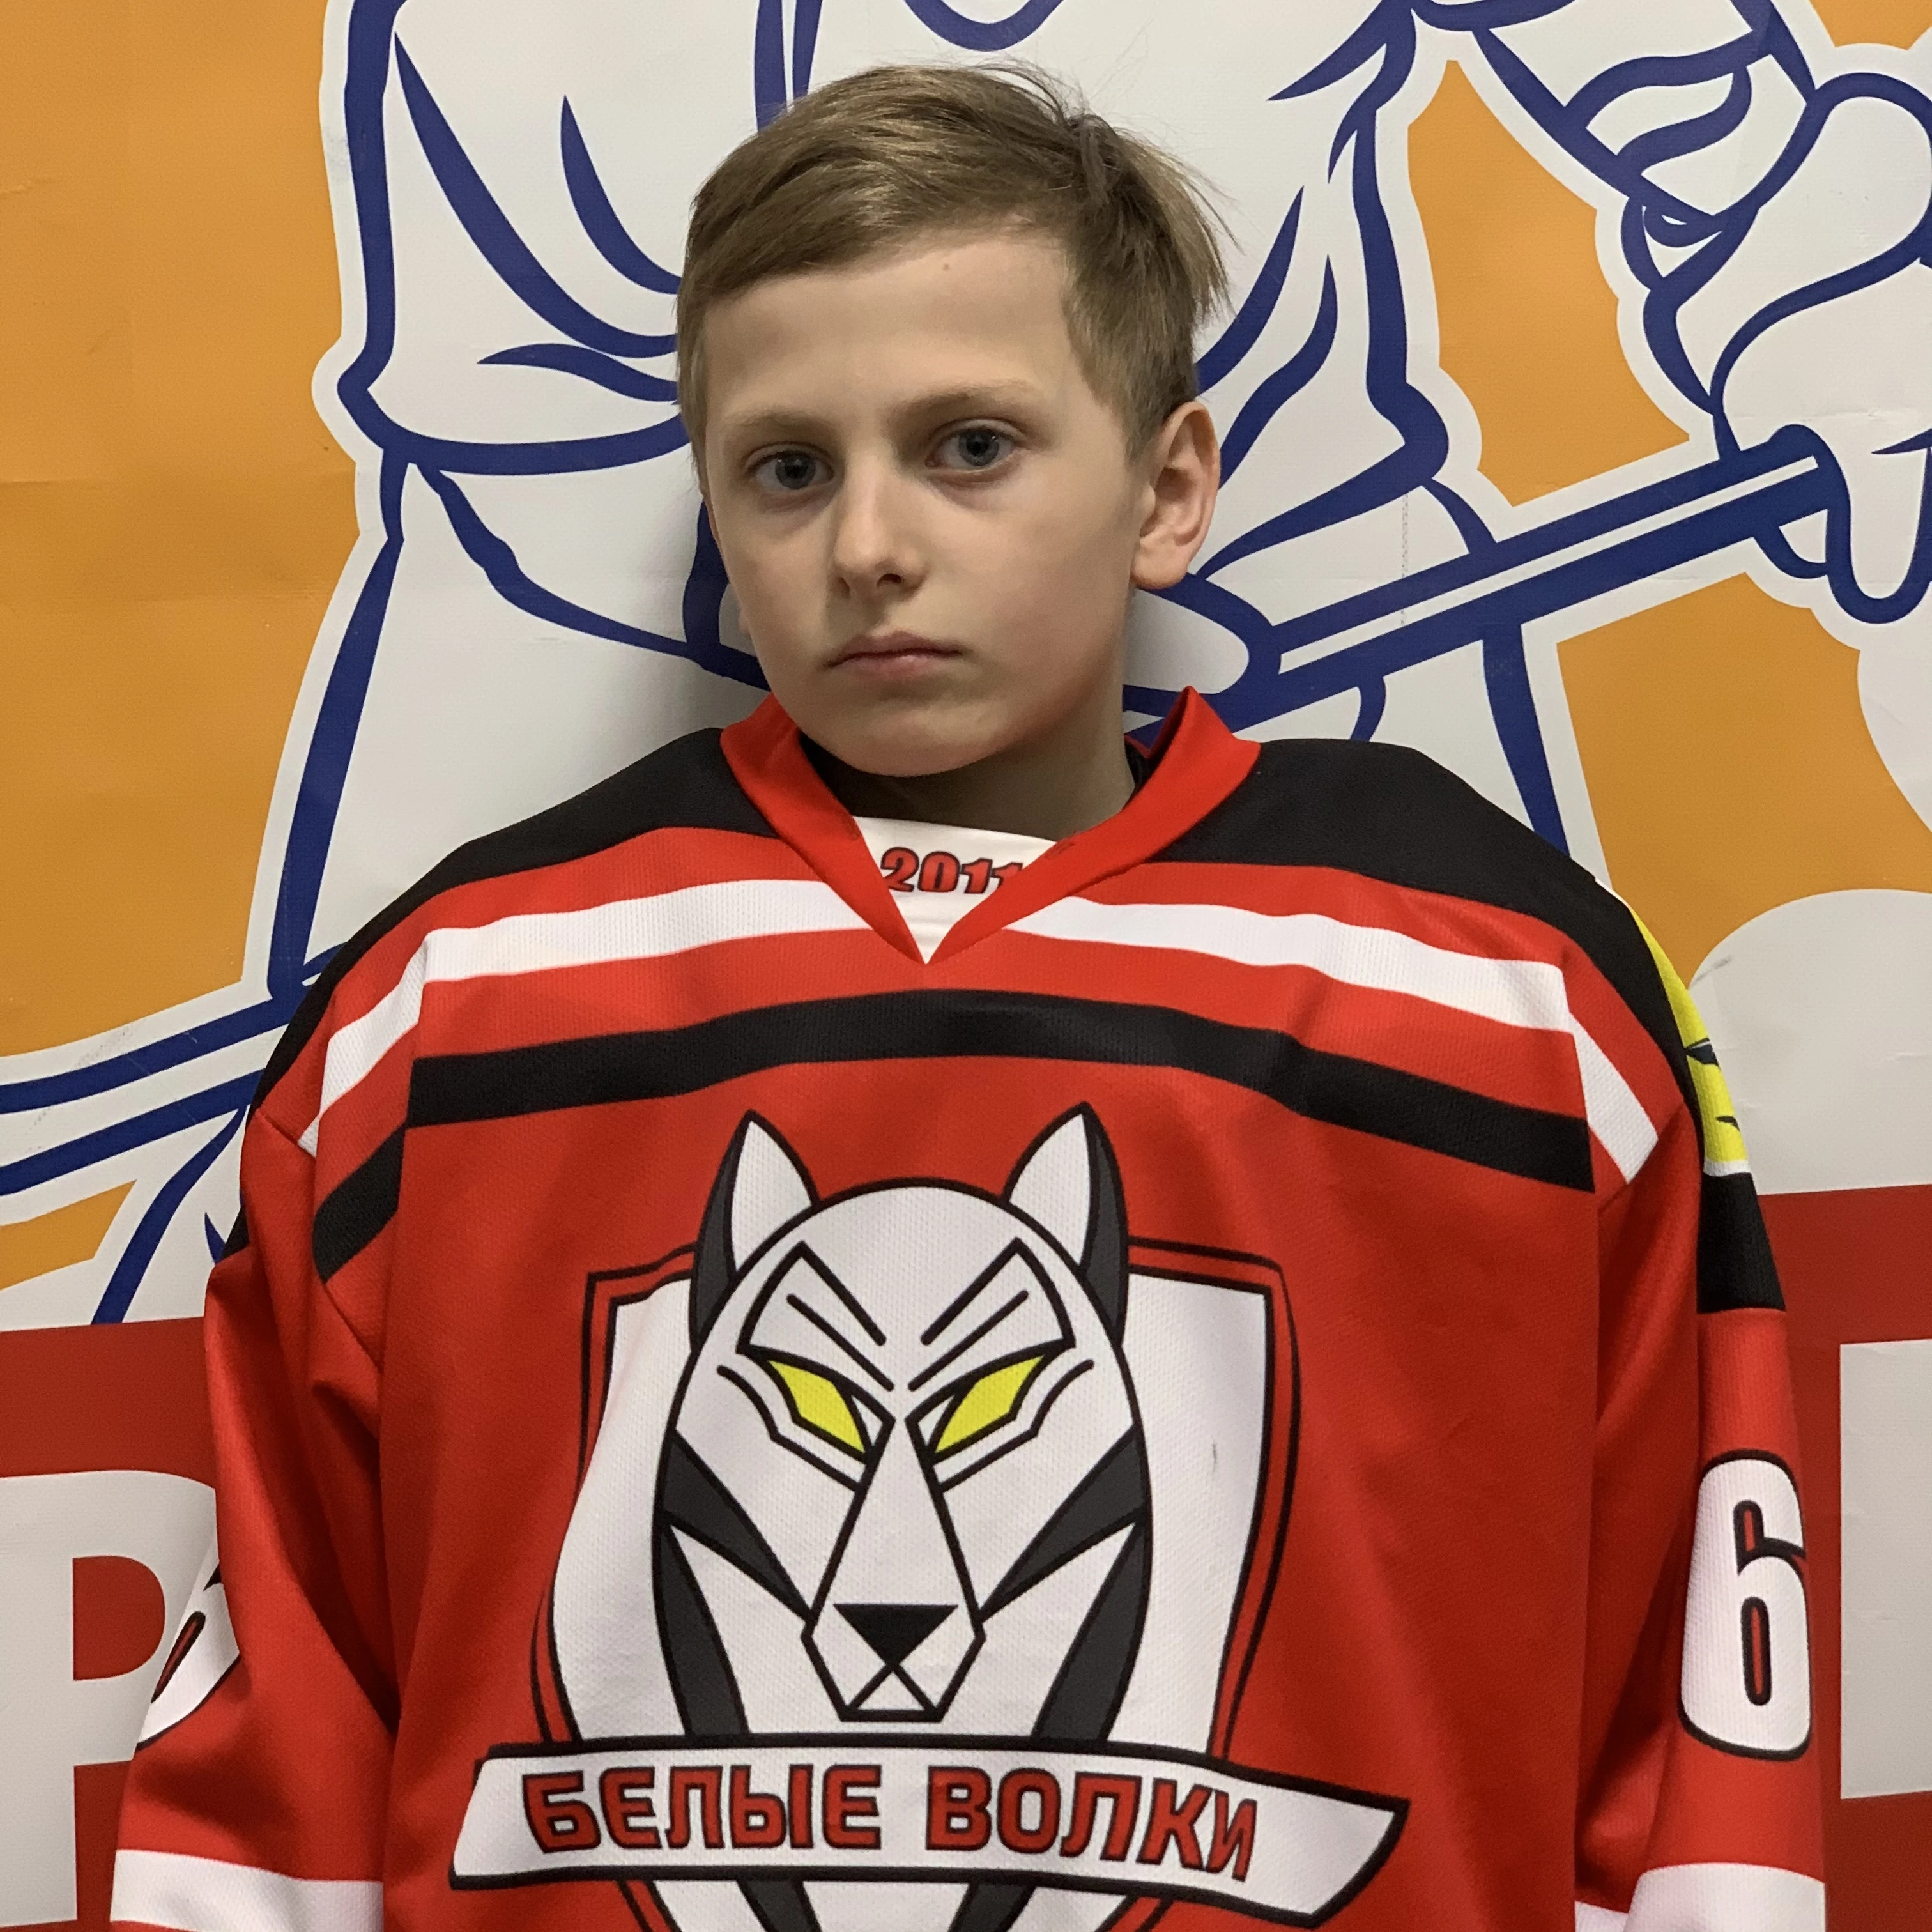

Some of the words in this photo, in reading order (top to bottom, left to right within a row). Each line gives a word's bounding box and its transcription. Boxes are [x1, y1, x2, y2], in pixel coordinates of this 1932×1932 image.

[1678, 1449, 1813, 1760] 6
[522, 1764, 882, 1853] БЕЛЫЕ
[926, 1766, 1259, 1882] ВОЛКИ
